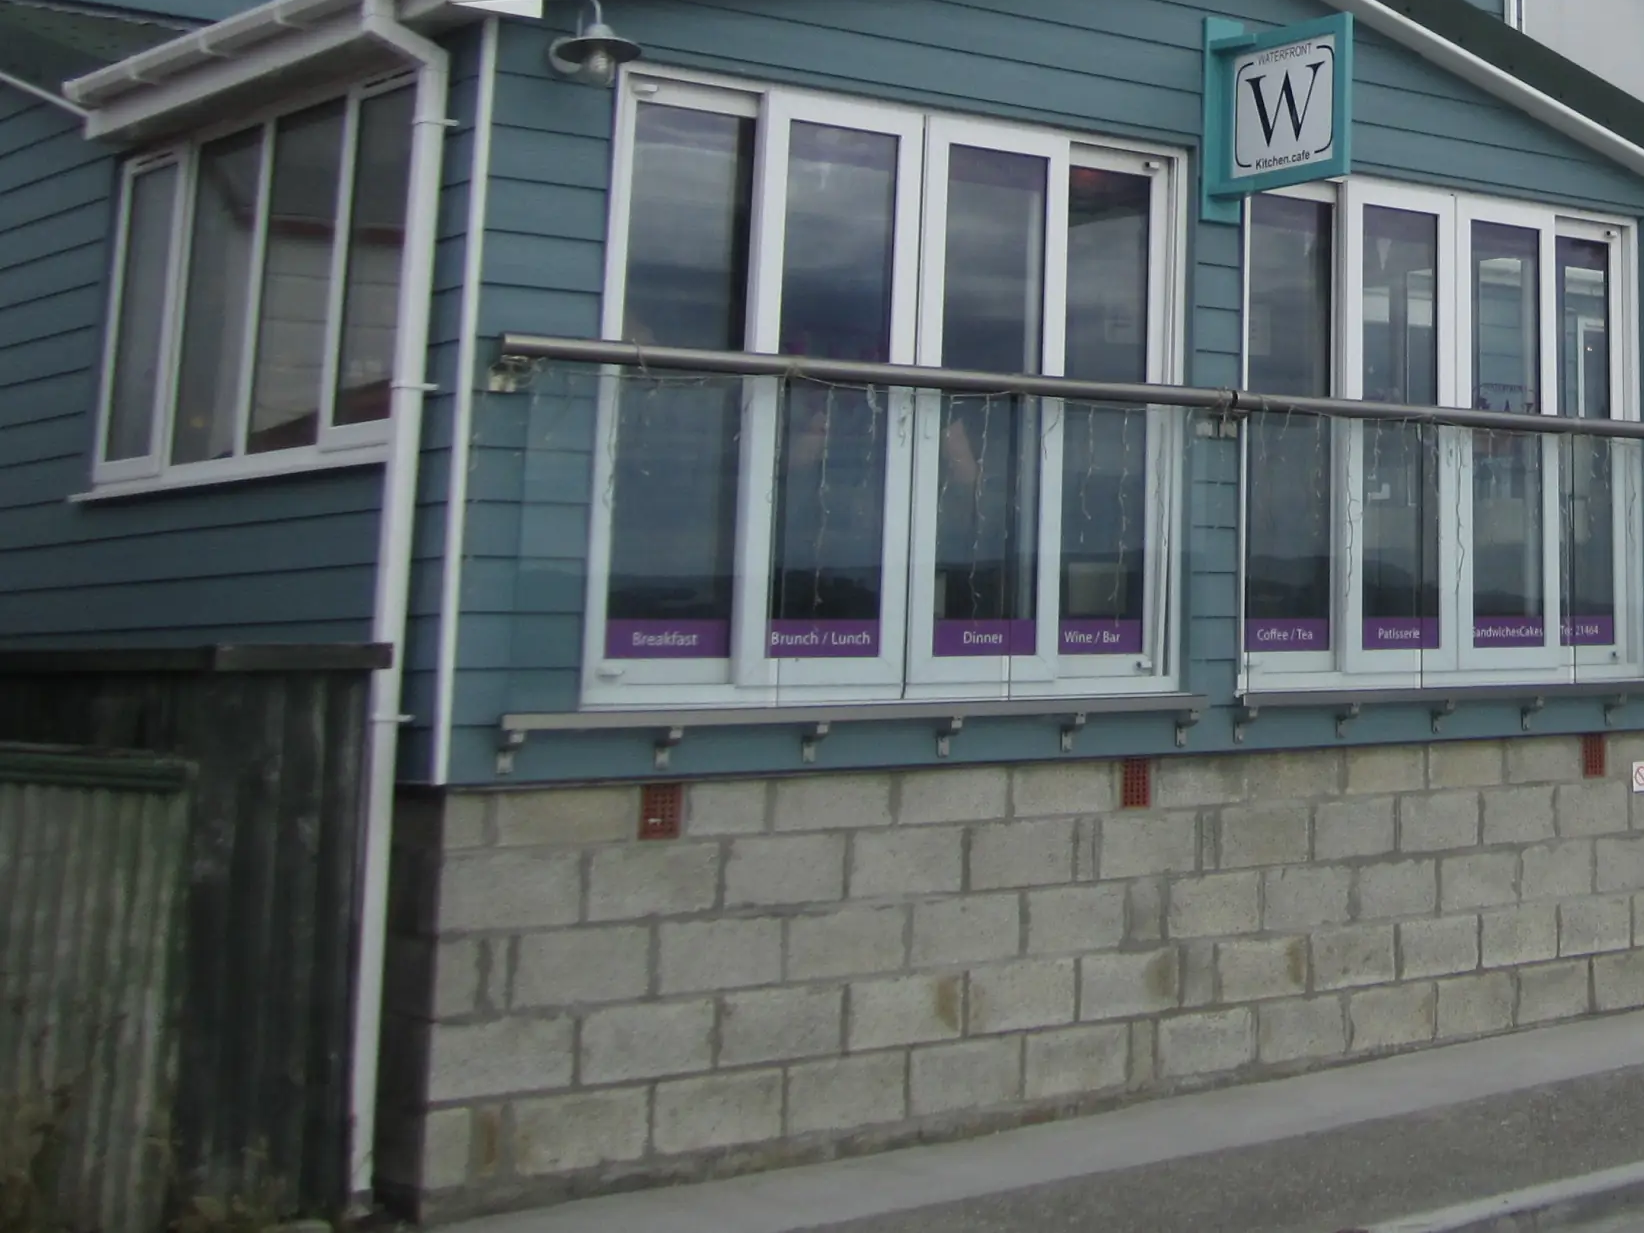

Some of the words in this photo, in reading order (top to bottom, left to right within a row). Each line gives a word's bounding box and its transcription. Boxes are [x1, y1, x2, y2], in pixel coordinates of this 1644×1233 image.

[1257, 42, 1312, 66] WATERFRONT
[1244, 60, 1325, 148] W
[632, 631, 698, 646] Breakfast
[771, 630, 819, 645] Brunch
[831, 631, 870, 645] Lunch
[963, 631, 1003, 644] Dinner
[1064, 631, 1092, 643] Wine
[1103, 631, 1120, 643] Bar
[1257, 629, 1289, 641] Coffee
[1297, 629, 1313, 640] Tea
[1378, 628, 1420, 639] Patisserie
